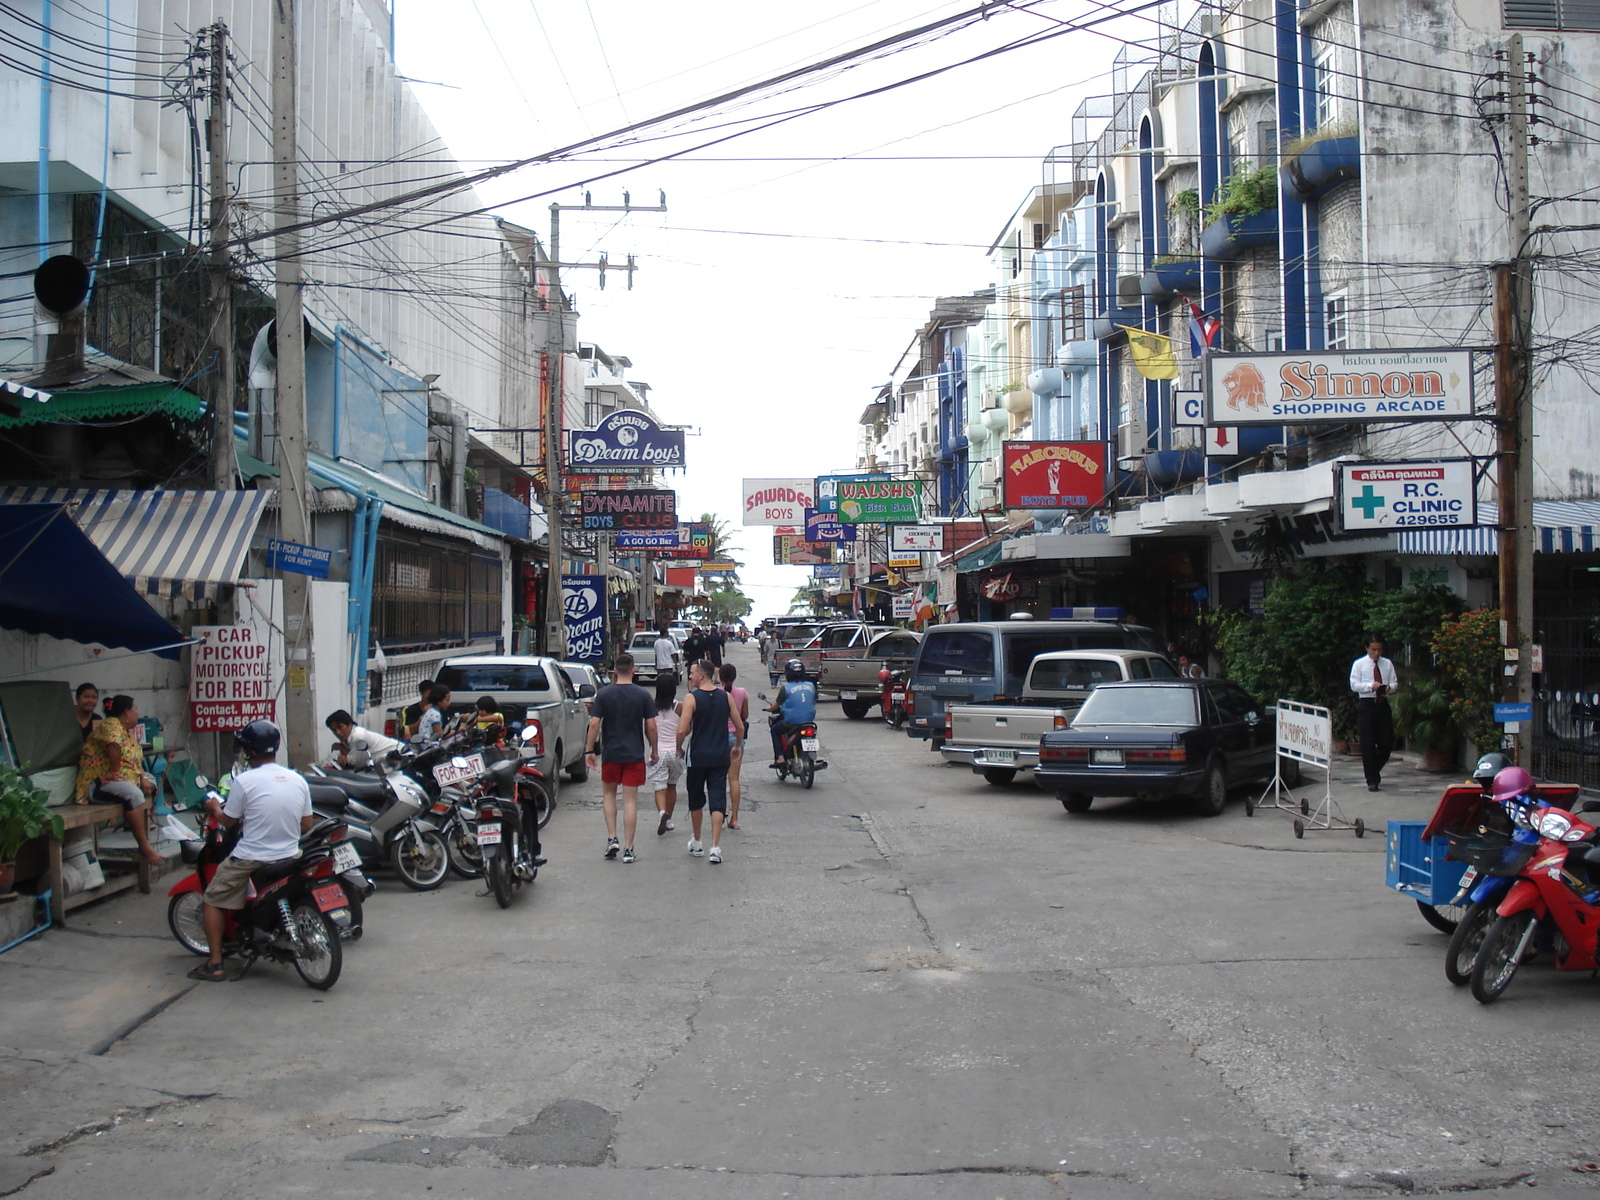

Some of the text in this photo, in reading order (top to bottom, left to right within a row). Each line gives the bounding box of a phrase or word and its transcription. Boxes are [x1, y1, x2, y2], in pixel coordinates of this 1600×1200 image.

[1279, 361, 1446, 402] Simon
[1184, 399, 1204, 418] C
[1273, 400, 1446, 415] SHOPPING ARCADE
[574, 442, 680, 464] Dream boys
[1010, 446, 1099, 476] NARCISSUS
[840, 483, 916, 499] WALSHS
[1403, 483, 1443, 497] R.C.
[583, 495, 674, 513] DYNAMITE
[746, 487, 812, 512] SAWADEE
[1021, 496, 1088, 506] BOYS PUB
[1392, 499, 1463, 513] CLINIC
[765, 508, 793, 519] BOYS
[1396, 514, 1459, 525] 429655
[584, 515, 675, 529] BOYS CLUB
[631, 537, 643, 545] GO
[645, 537, 658, 545] GO
[218, 628, 251, 643] CAR
[203, 645, 266, 661] PICKUP
[566, 631, 604, 659] boys
[196, 662, 272, 678] MOTORCYCLE
[195, 680, 272, 699] FOR RENT
[195, 704, 238, 716] Contact.
[438, 766, 458, 782] FOR
[340, 859, 356, 870] 730
